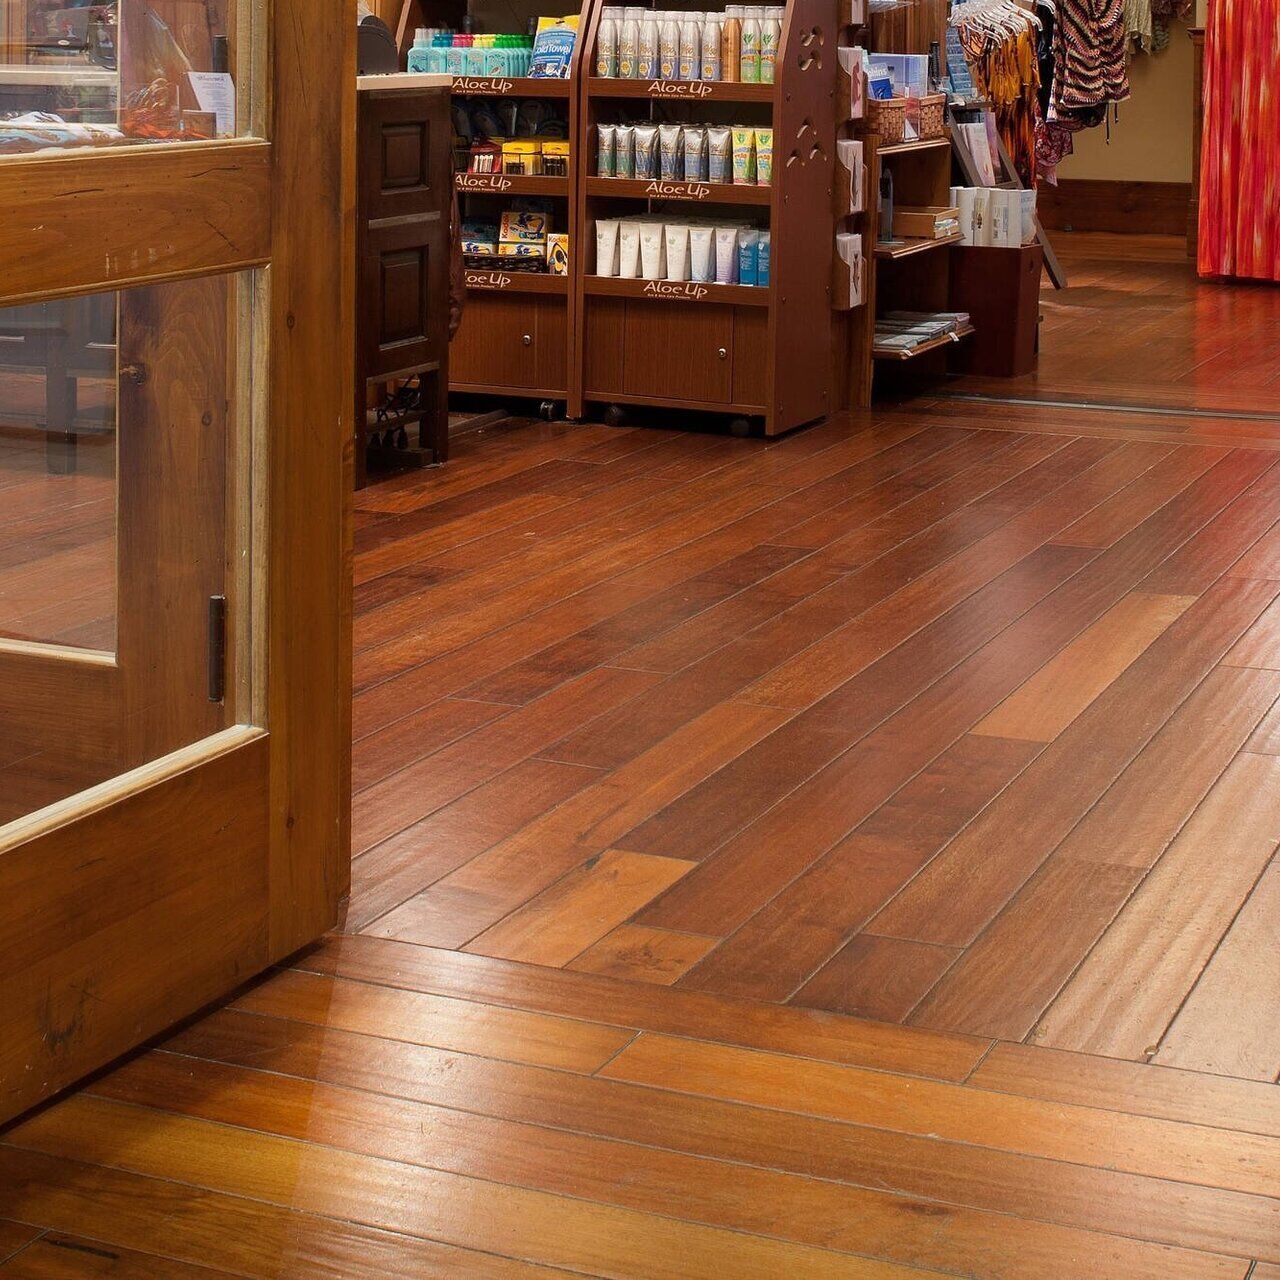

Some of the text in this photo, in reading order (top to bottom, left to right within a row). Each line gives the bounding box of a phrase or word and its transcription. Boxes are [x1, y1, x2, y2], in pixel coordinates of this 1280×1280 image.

[452, 77, 513, 93] Aloe Up
[648, 81, 712, 97] Aloe Up
[455, 175, 489, 187] Aloe
[490, 176, 512, 191] Up
[645, 182, 710, 199] Aloe Up
[489, 273, 511, 288] Up
[643, 281, 708, 299] Aloe Up
